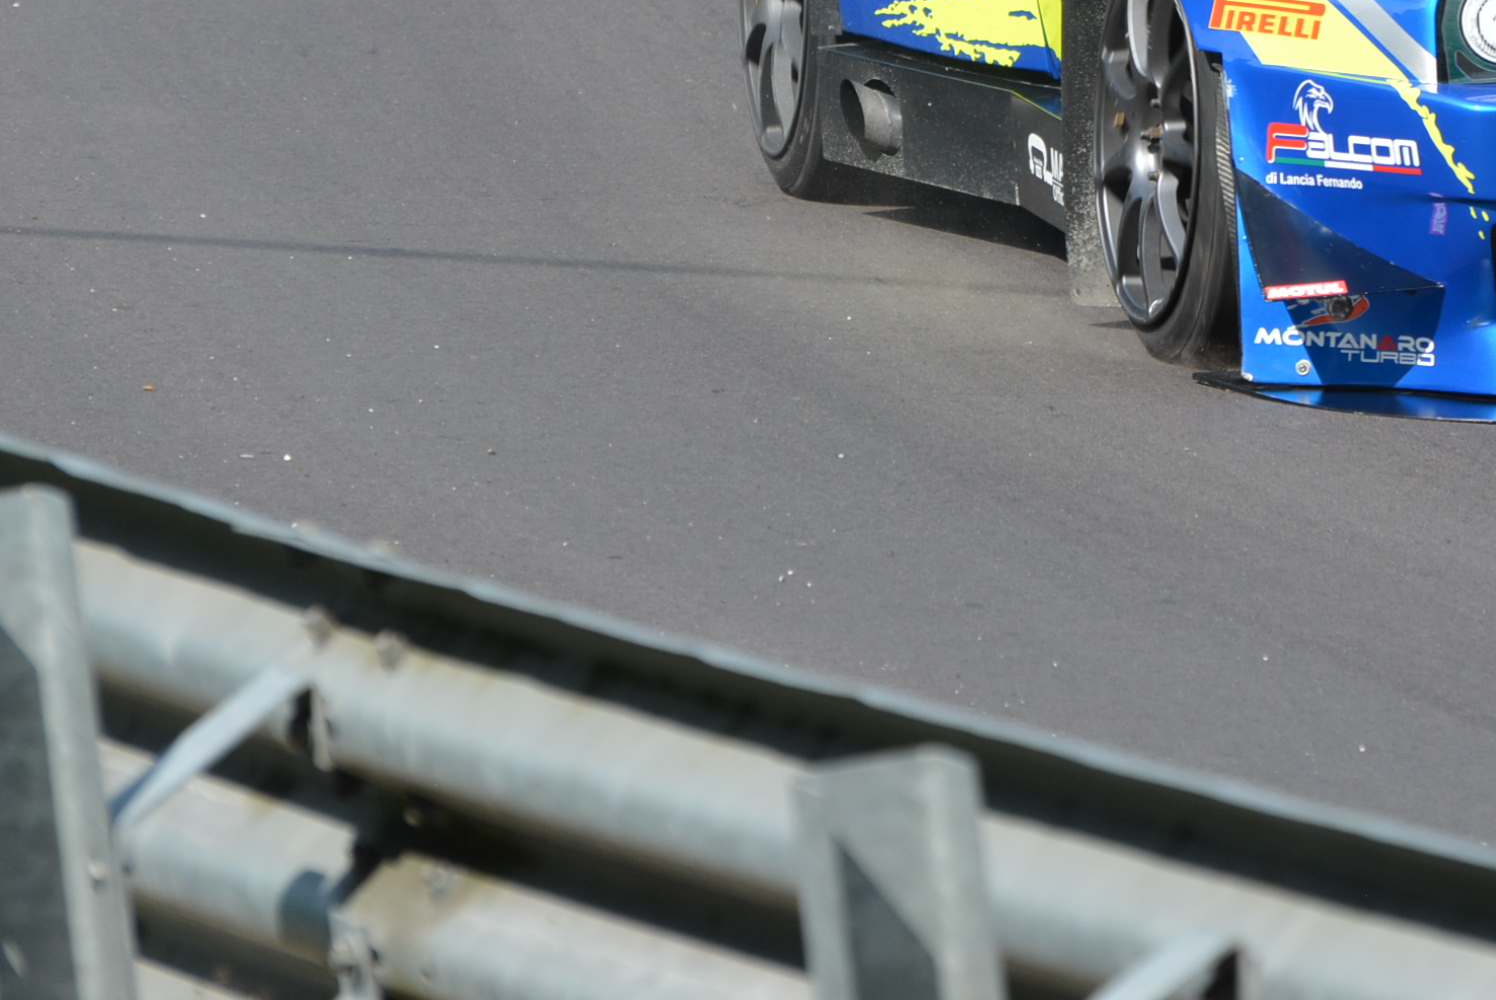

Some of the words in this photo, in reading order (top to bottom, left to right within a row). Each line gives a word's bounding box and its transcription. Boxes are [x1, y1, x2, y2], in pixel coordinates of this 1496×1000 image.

[1266, 172, 1278, 184] di
[1280, 173, 1315, 186] Lancia
[1317, 175, 1363, 190] Fernando
[1268, 283, 1344, 298] MOTUL
[1254, 327, 1435, 354] MONTANARO
[1340, 349, 1435, 366] TURBO
